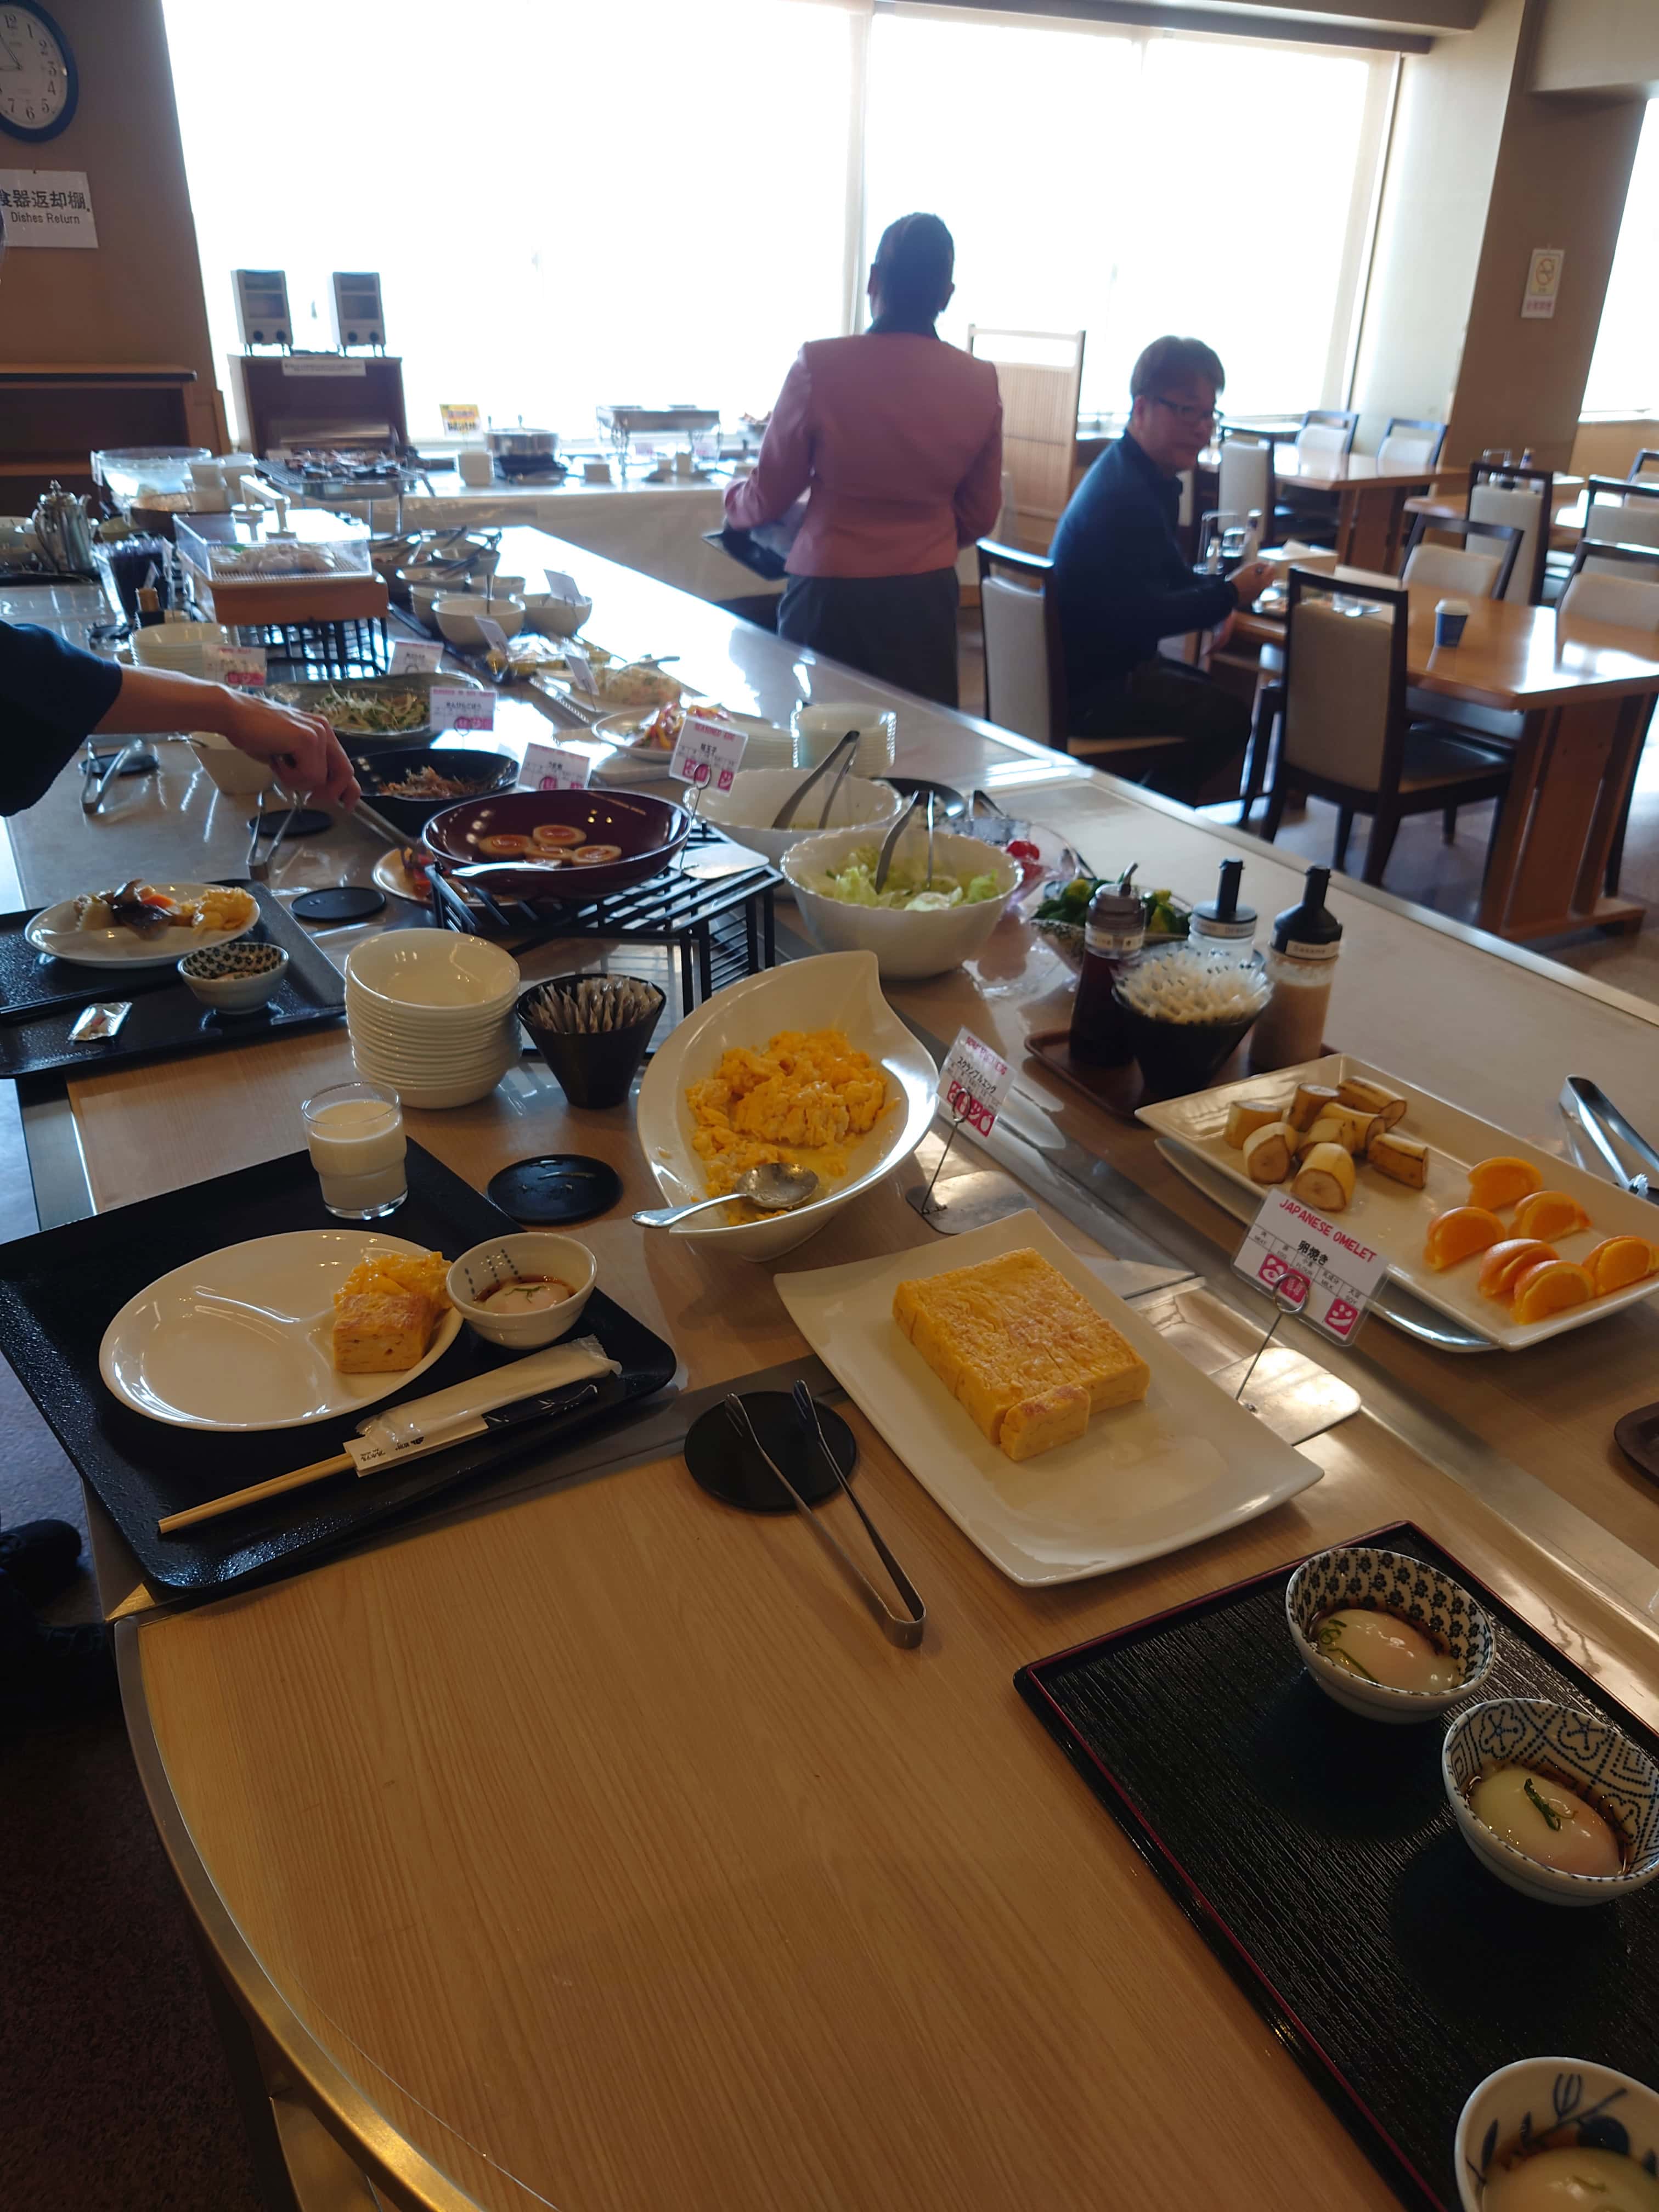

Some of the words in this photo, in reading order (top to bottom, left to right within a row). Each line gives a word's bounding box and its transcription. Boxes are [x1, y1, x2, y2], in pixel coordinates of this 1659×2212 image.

[4, 14, 16, 29] 12
[39, 39, 48, 55] 2
[47, 61, 57, 76] 3
[48, 81, 56, 95] 4
[8, 98, 14, 112] 7
[41, 99, 49, 114] 5
[26, 106, 35, 120] 6
[11, 212, 43, 223] Dishes
[46, 213, 80, 224] Return
[957, 1056, 997, 1094] スクランブルエッグ
[1279, 1199, 1333, 1236] JAPANESE
[1333, 1231, 1377, 1263] OMELET
[1297, 1240, 1329, 1266] 卵焼き
